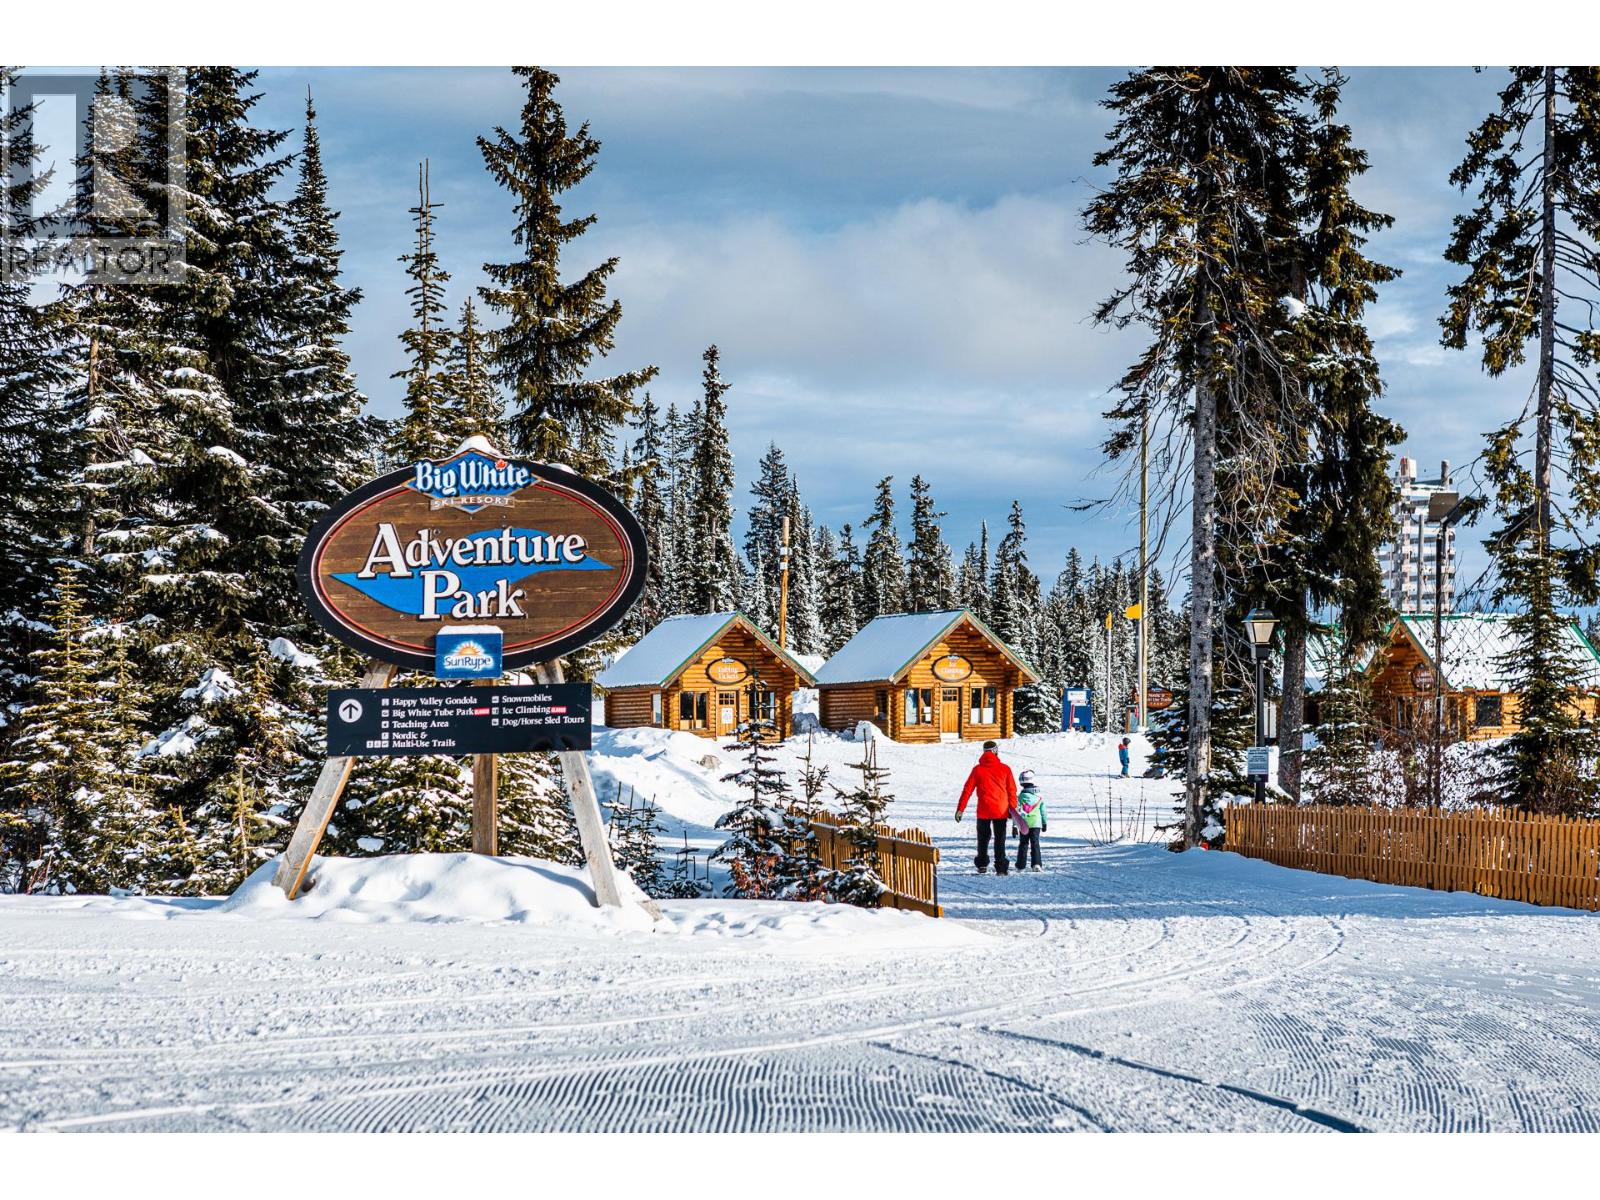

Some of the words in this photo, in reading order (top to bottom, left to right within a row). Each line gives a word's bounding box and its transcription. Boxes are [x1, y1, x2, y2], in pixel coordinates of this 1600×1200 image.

[415, 461, 457, 495] Big
[458, 460, 529, 489] White
[434, 498, 454, 508] SKI
[460, 496, 509, 505] RESORT
[357, 522, 586, 578] Adventure
[418, 570, 525, 620] Park
[445, 656, 491, 669] SunRype
[392, 698, 417, 707] Happy
[420, 697, 443, 706] Valley
[445, 696, 477, 705] Gondola
[502, 693, 552, 703] Snowmobiles
[392, 709, 406, 718] Big
[408, 708, 431, 717] White
[434, 708, 454, 716] Tube
[456, 708, 474, 716] Park
[502, 707, 513, 715] Ice
[515, 706, 551, 716] Climbing
[392, 720, 427, 729] Teaching
[502, 717, 543, 727] Dog/Horse
[545, 716, 560, 724] Sled
[562, 716, 585, 724] Tours
[392, 731, 418, 739] Nordic
[420, 731, 428, 739] &
[392, 740, 430, 748] Multi-Use
[432, 738, 456, 747] Trails
